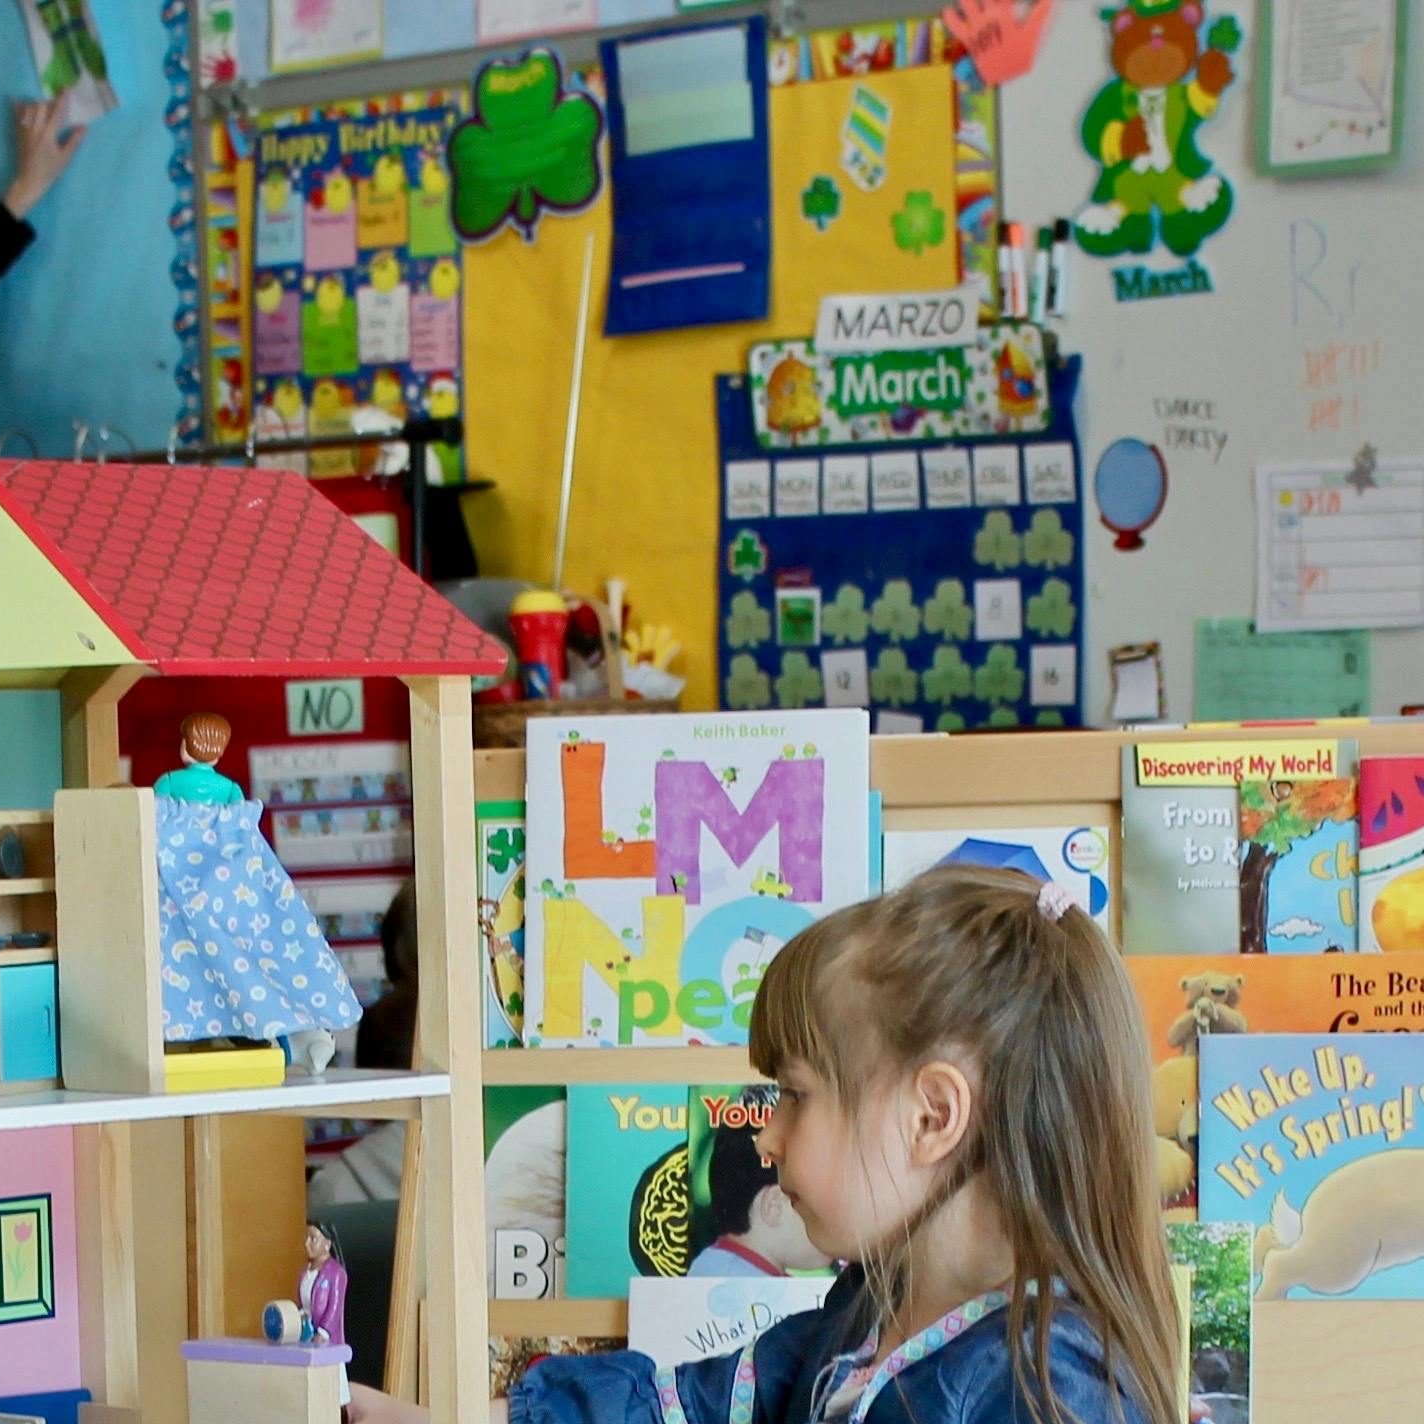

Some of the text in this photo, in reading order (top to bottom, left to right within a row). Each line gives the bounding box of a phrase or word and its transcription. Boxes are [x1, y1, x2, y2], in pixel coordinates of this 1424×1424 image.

[1112, 260, 1214, 302] March
[832, 299, 964, 341] MARZO
[840, 357, 964, 407] March
[299, 686, 356, 734] NO
[693, 722, 786, 741] Keith Baker
[1141, 749, 1333, 783] Discovering My World
[1161, 801, 1233, 830] From
[1183, 836, 1216, 867] to
[1177, 877, 1189, 894] by
[1331, 972, 1377, 999] The
[1374, 1001, 1406, 1019] and
[1212, 1045, 1376, 1132] Wake Up,
[1214, 1084, 1415, 1200] It's Spring!
[684, 1320, 746, 1355] What
